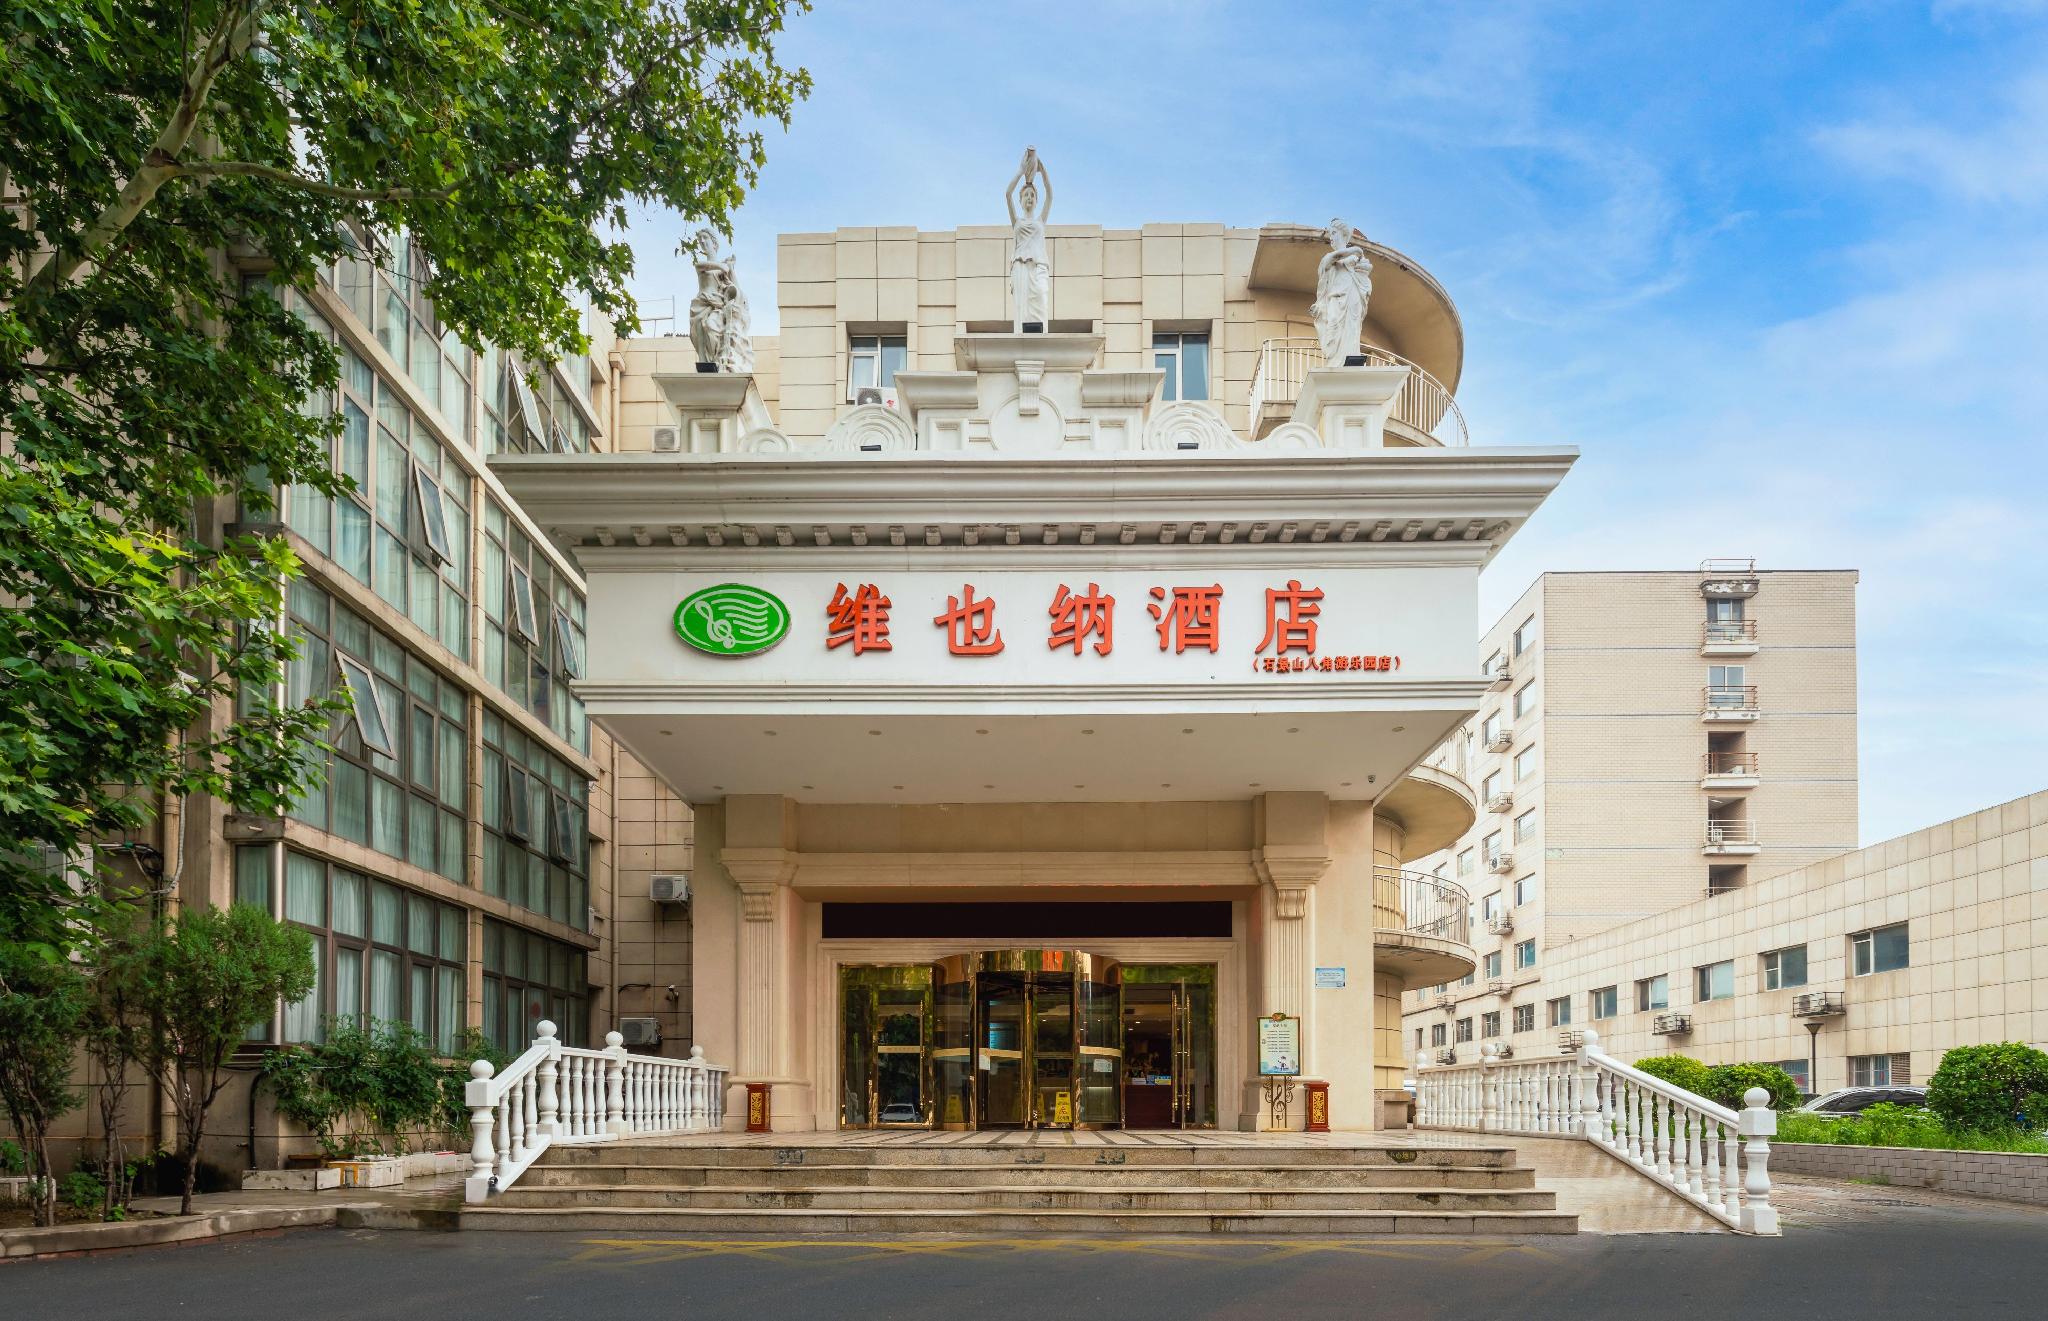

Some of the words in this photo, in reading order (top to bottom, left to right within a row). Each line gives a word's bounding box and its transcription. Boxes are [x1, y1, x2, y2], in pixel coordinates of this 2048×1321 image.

[825, 579, 1325, 658] 维也纳酒店
